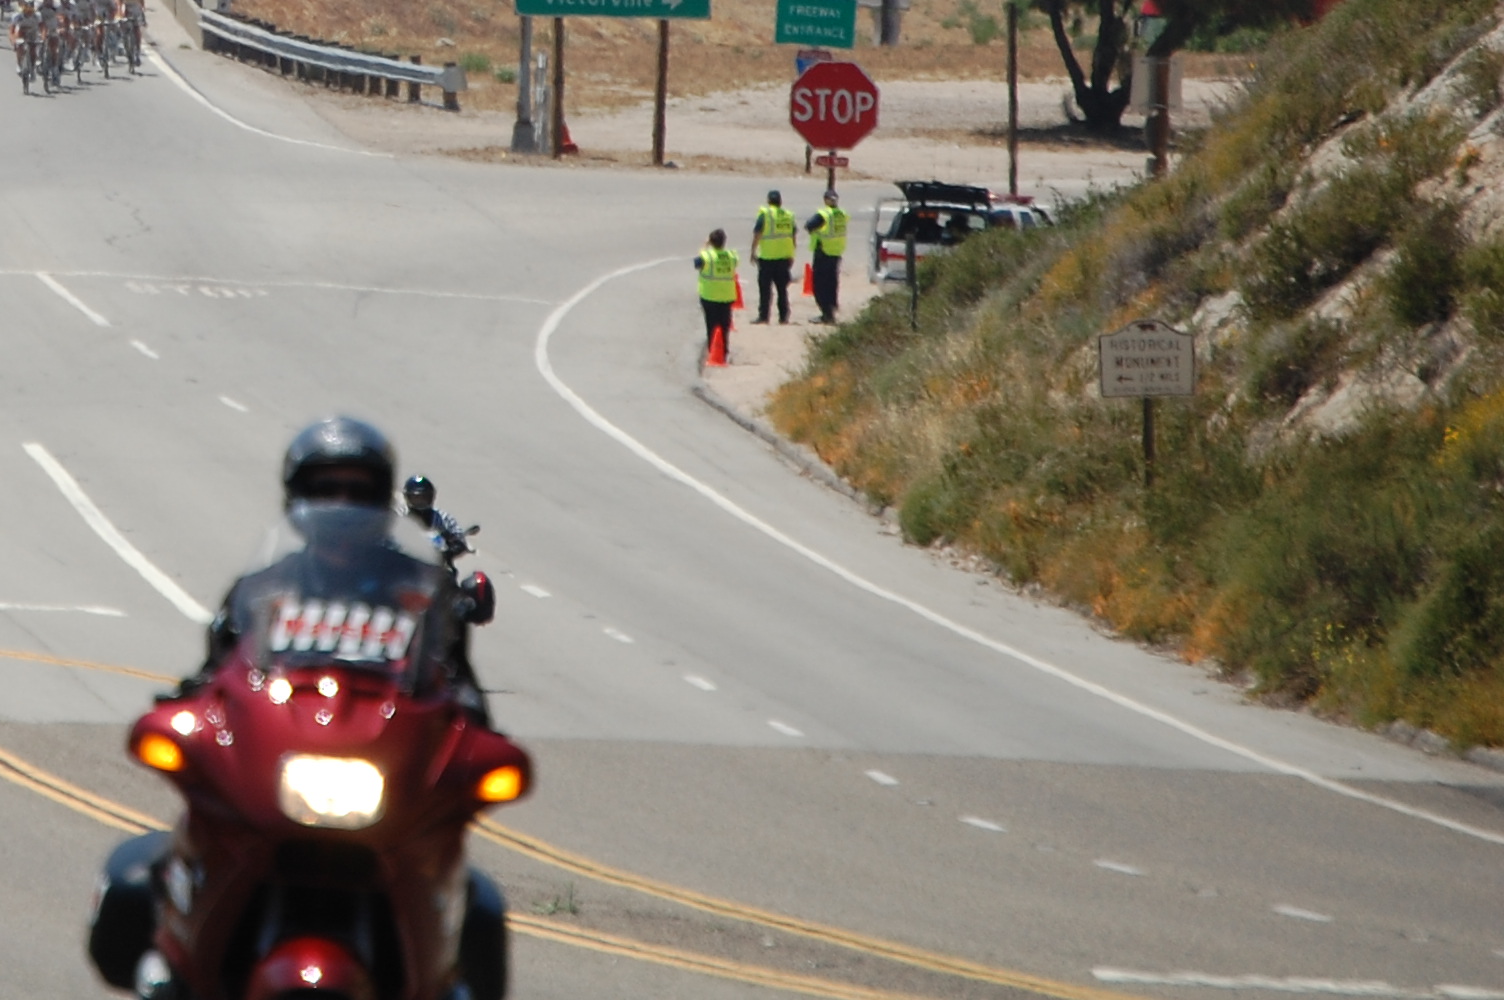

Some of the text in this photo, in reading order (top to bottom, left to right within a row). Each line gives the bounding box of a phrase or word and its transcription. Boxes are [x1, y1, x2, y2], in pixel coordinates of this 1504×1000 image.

[789, 5, 841, 19] FREEWAY
[783, 24, 846, 40] ENTRANCE
[793, 87, 875, 124] STOP
